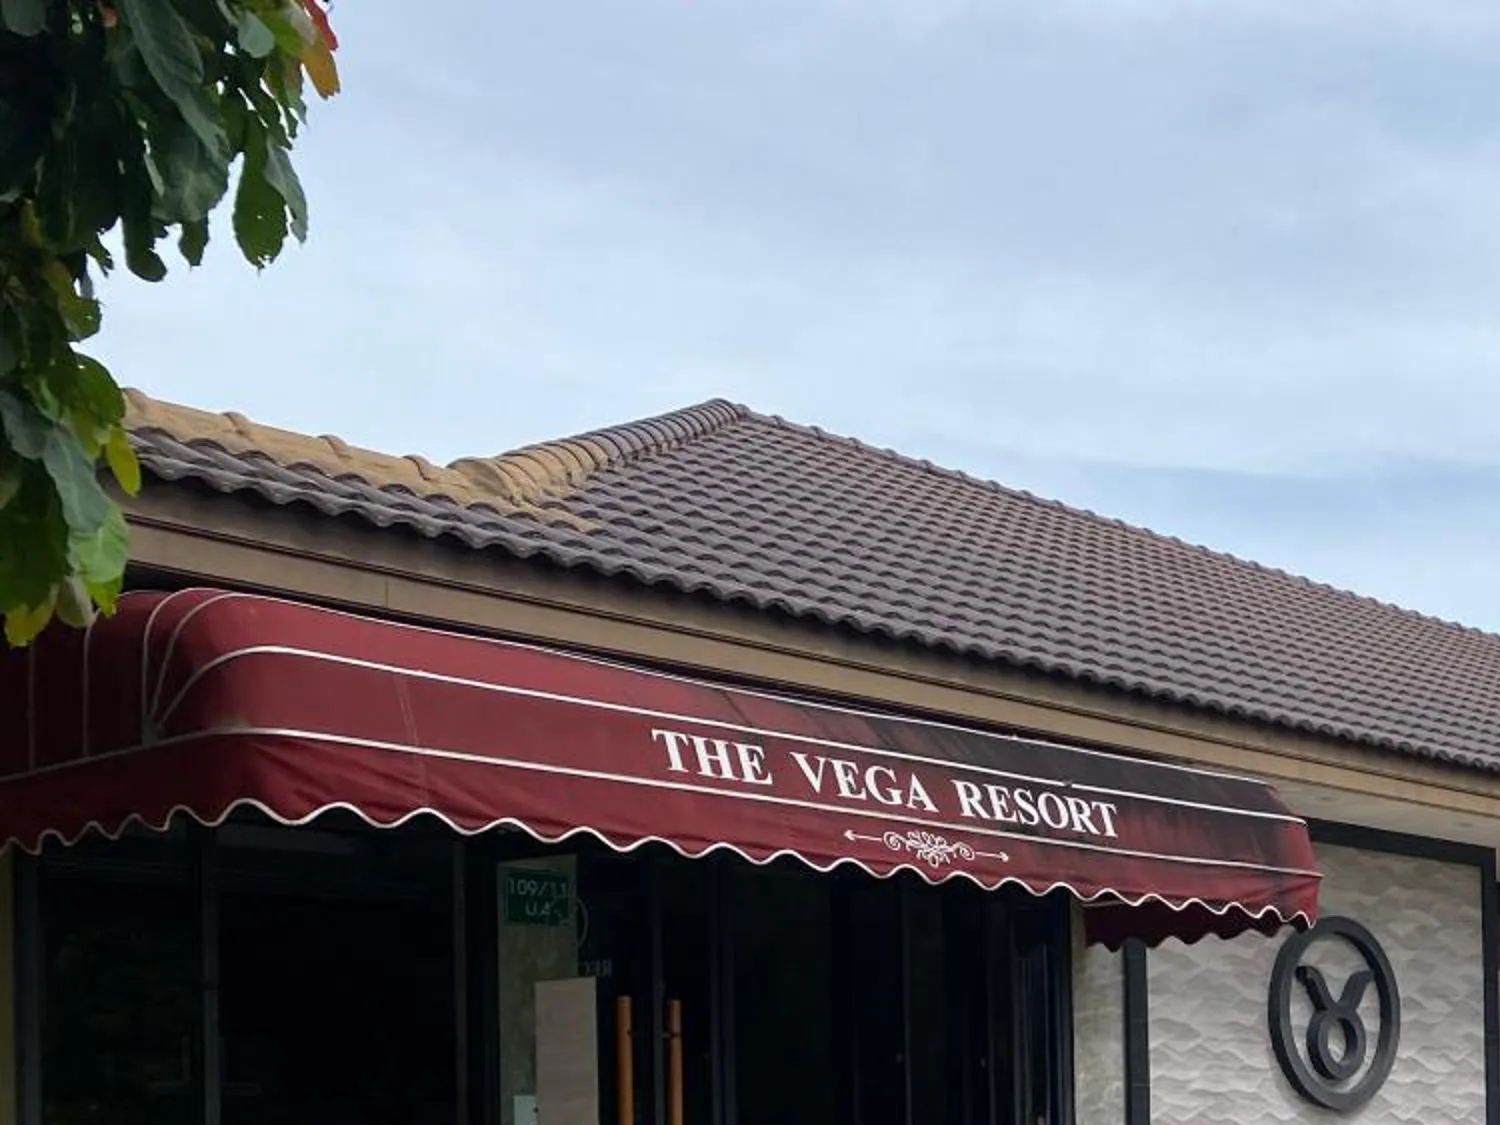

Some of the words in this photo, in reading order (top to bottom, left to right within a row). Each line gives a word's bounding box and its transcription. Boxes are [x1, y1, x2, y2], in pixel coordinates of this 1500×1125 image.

[652, 729, 773, 785] THE
[790, 752, 938, 811] VEGA
[952, 779, 1117, 838] RESORT
